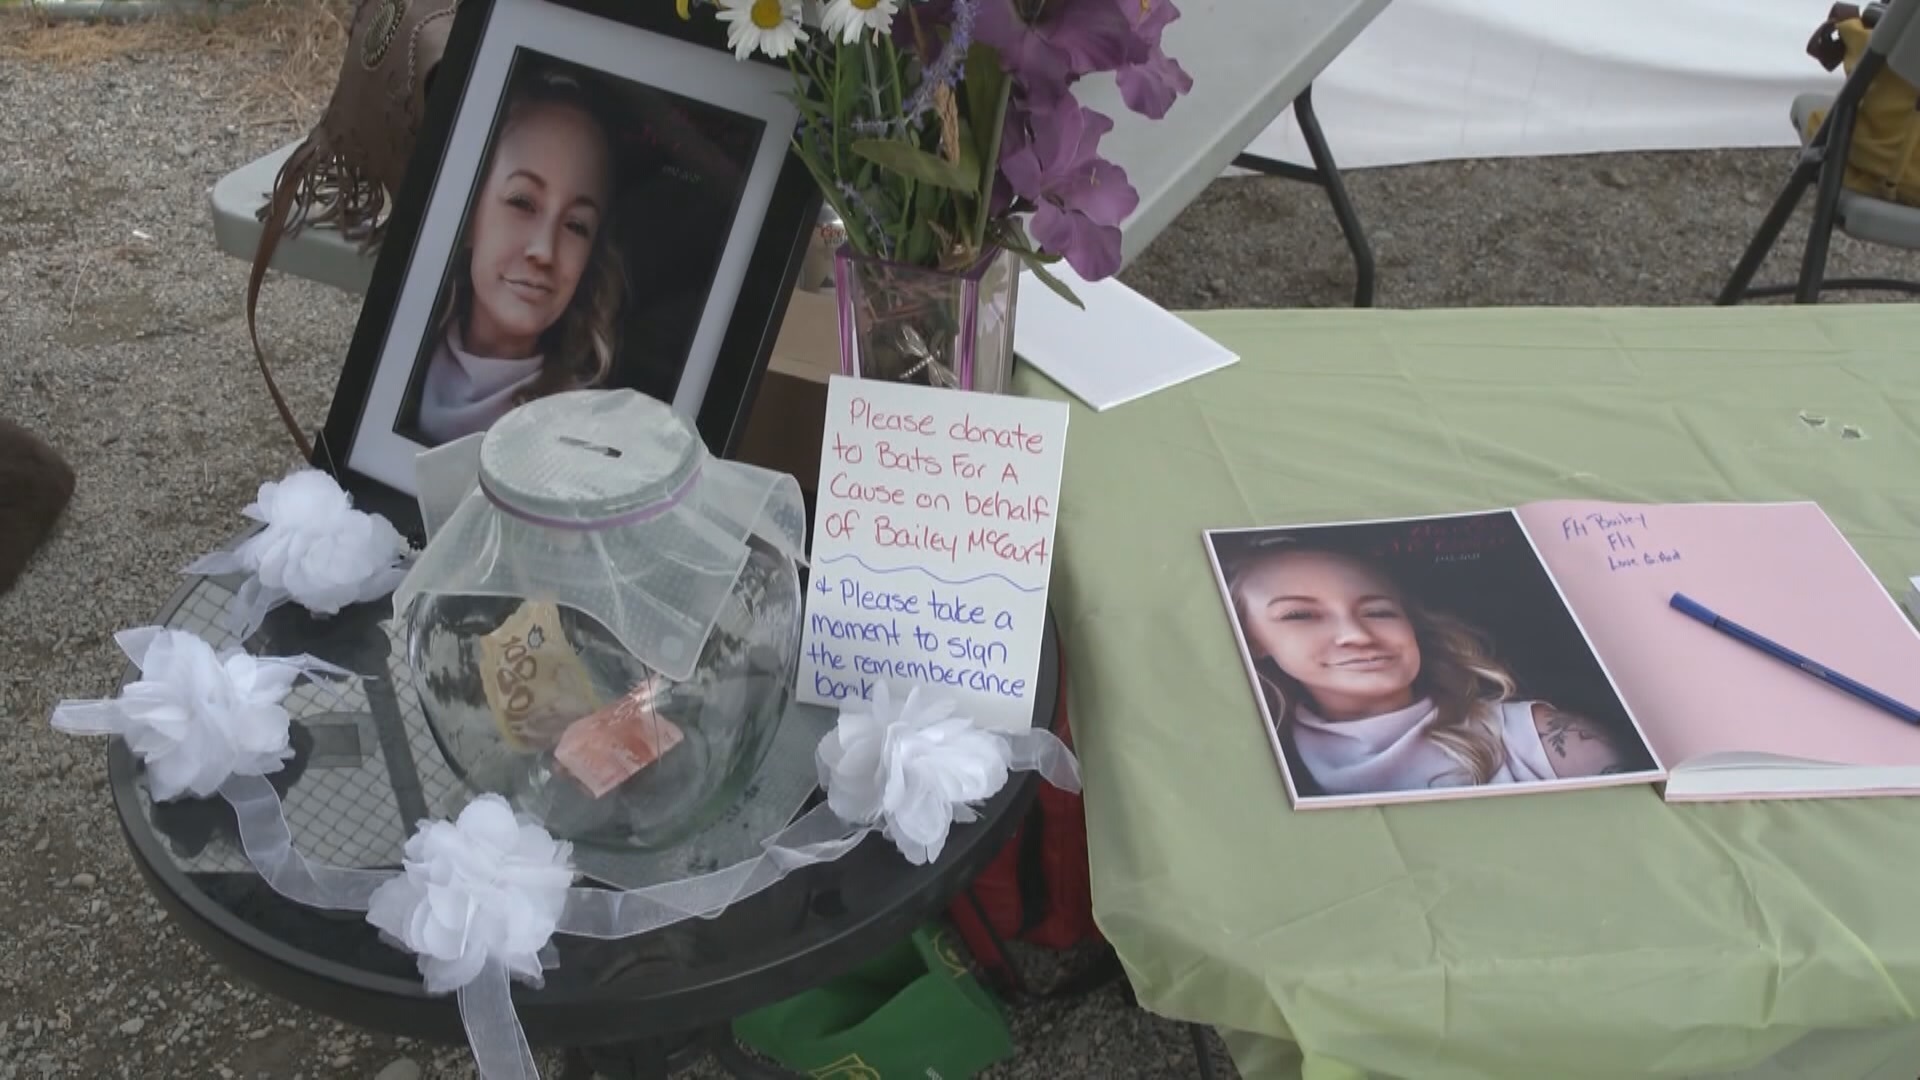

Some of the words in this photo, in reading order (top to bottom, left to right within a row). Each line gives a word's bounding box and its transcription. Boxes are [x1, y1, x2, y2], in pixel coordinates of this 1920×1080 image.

[850, 397, 936, 435] Please
[949, 413, 1043, 454] donate
[832, 433, 862, 464] to
[876, 441, 942, 475] Bats
[952, 455, 986, 479] For
[1002, 464, 1018, 484] A
[830, 473, 905, 505] Cause
[916, 494, 950, 511] on
[965, 491, 1050, 522] behalf
[875, 515, 958, 562] Bailey
[840, 579, 919, 614] Please
[928, 590, 986, 624] take
[994, 610, 1013, 630] a
[913, 626, 938, 652] to
[807, 644, 845, 669] the
[854, 655, 1025, 698] rememberance
